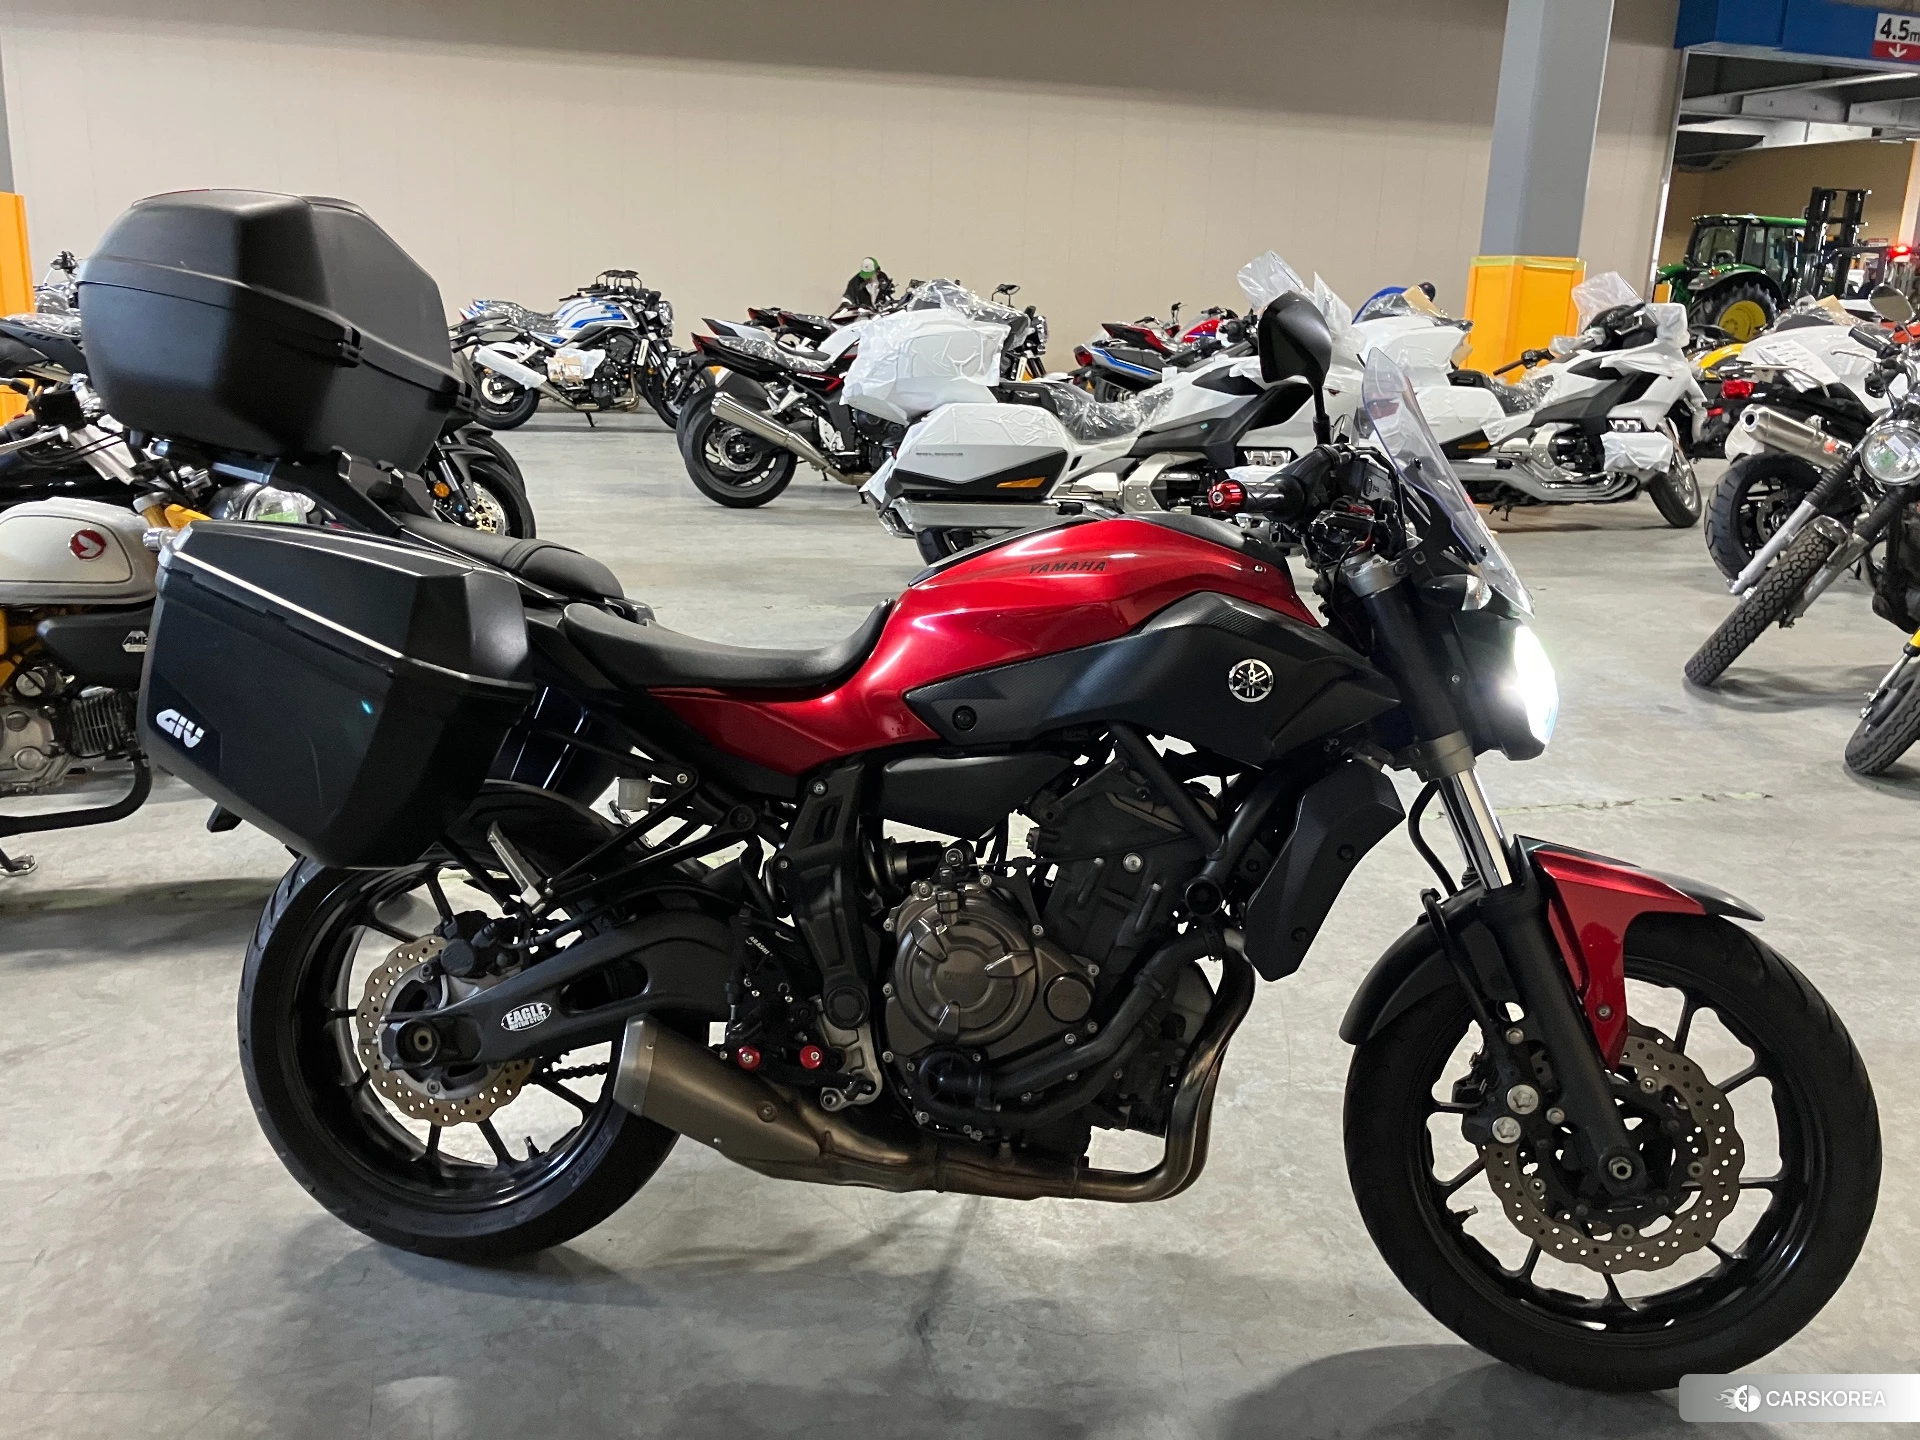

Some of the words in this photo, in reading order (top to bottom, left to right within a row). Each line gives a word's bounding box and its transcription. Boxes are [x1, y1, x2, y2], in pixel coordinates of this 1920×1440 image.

[1880, 18, 1920, 43] 4.5m
[1029, 561, 1106, 574] YAMAHA
[506, 1003, 546, 1025] EAGLE
